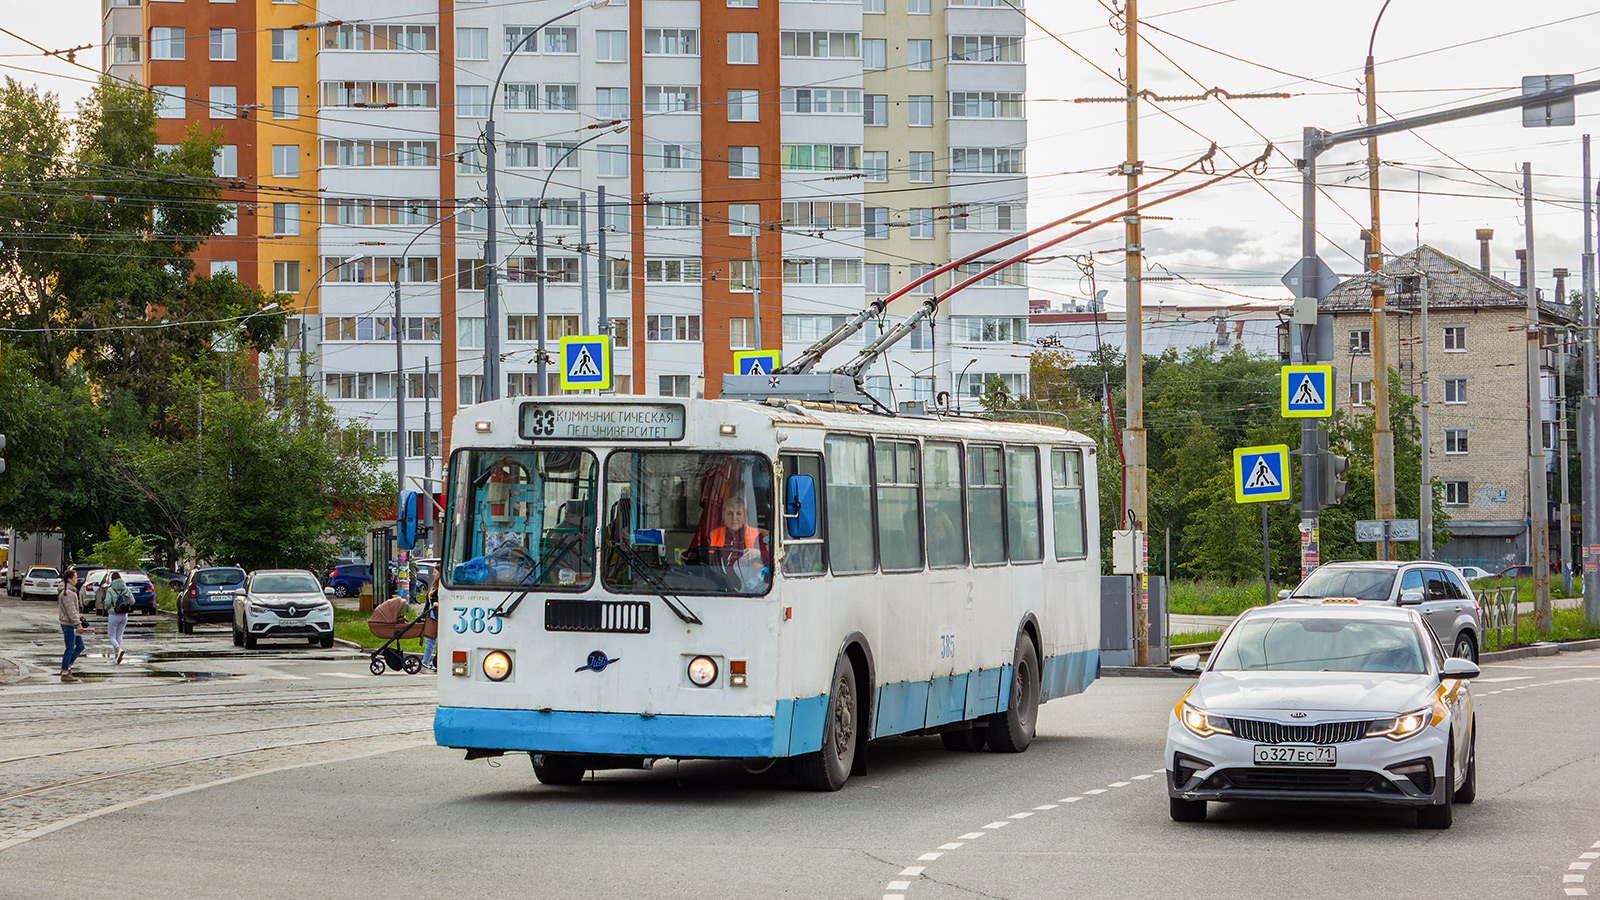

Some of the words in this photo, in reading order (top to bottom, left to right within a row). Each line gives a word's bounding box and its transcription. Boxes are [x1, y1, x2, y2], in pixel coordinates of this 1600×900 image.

[532, 409, 555, 436] 33
[452, 606, 503, 635] 385
[940, 634, 955, 659] 385
